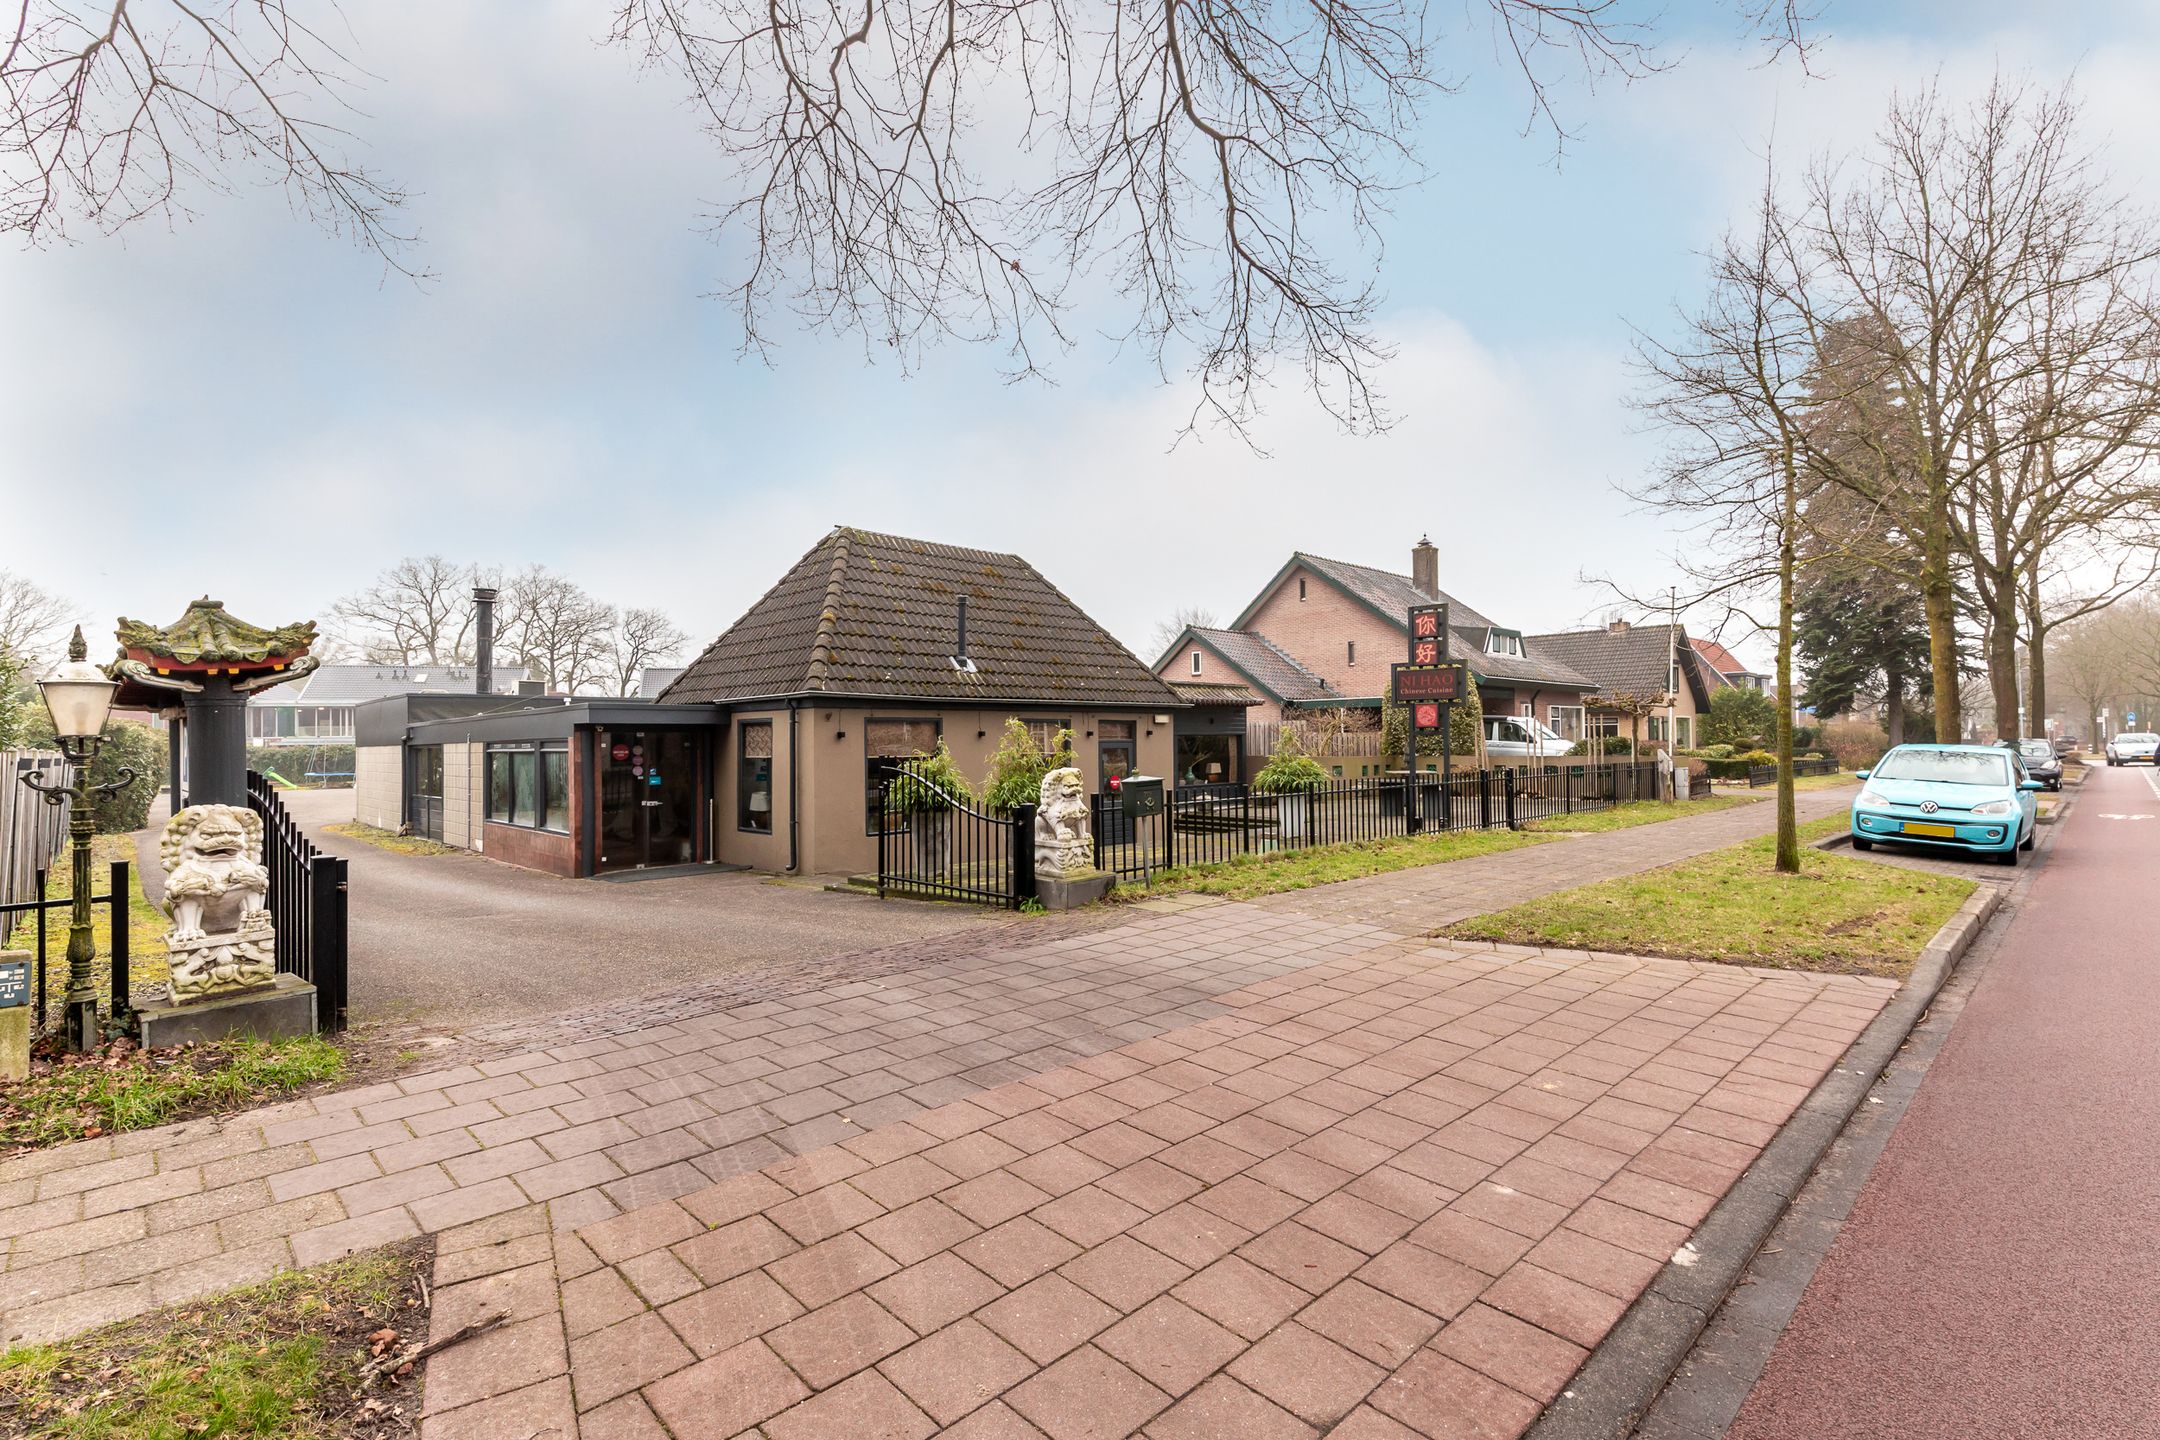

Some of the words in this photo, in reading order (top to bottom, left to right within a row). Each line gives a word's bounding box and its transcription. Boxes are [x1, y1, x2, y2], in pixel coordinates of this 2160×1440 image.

[1415, 615, 1436, 663] 你好
[1401, 675, 1416, 687] NI
[1421, 674, 1454, 686] HAO
